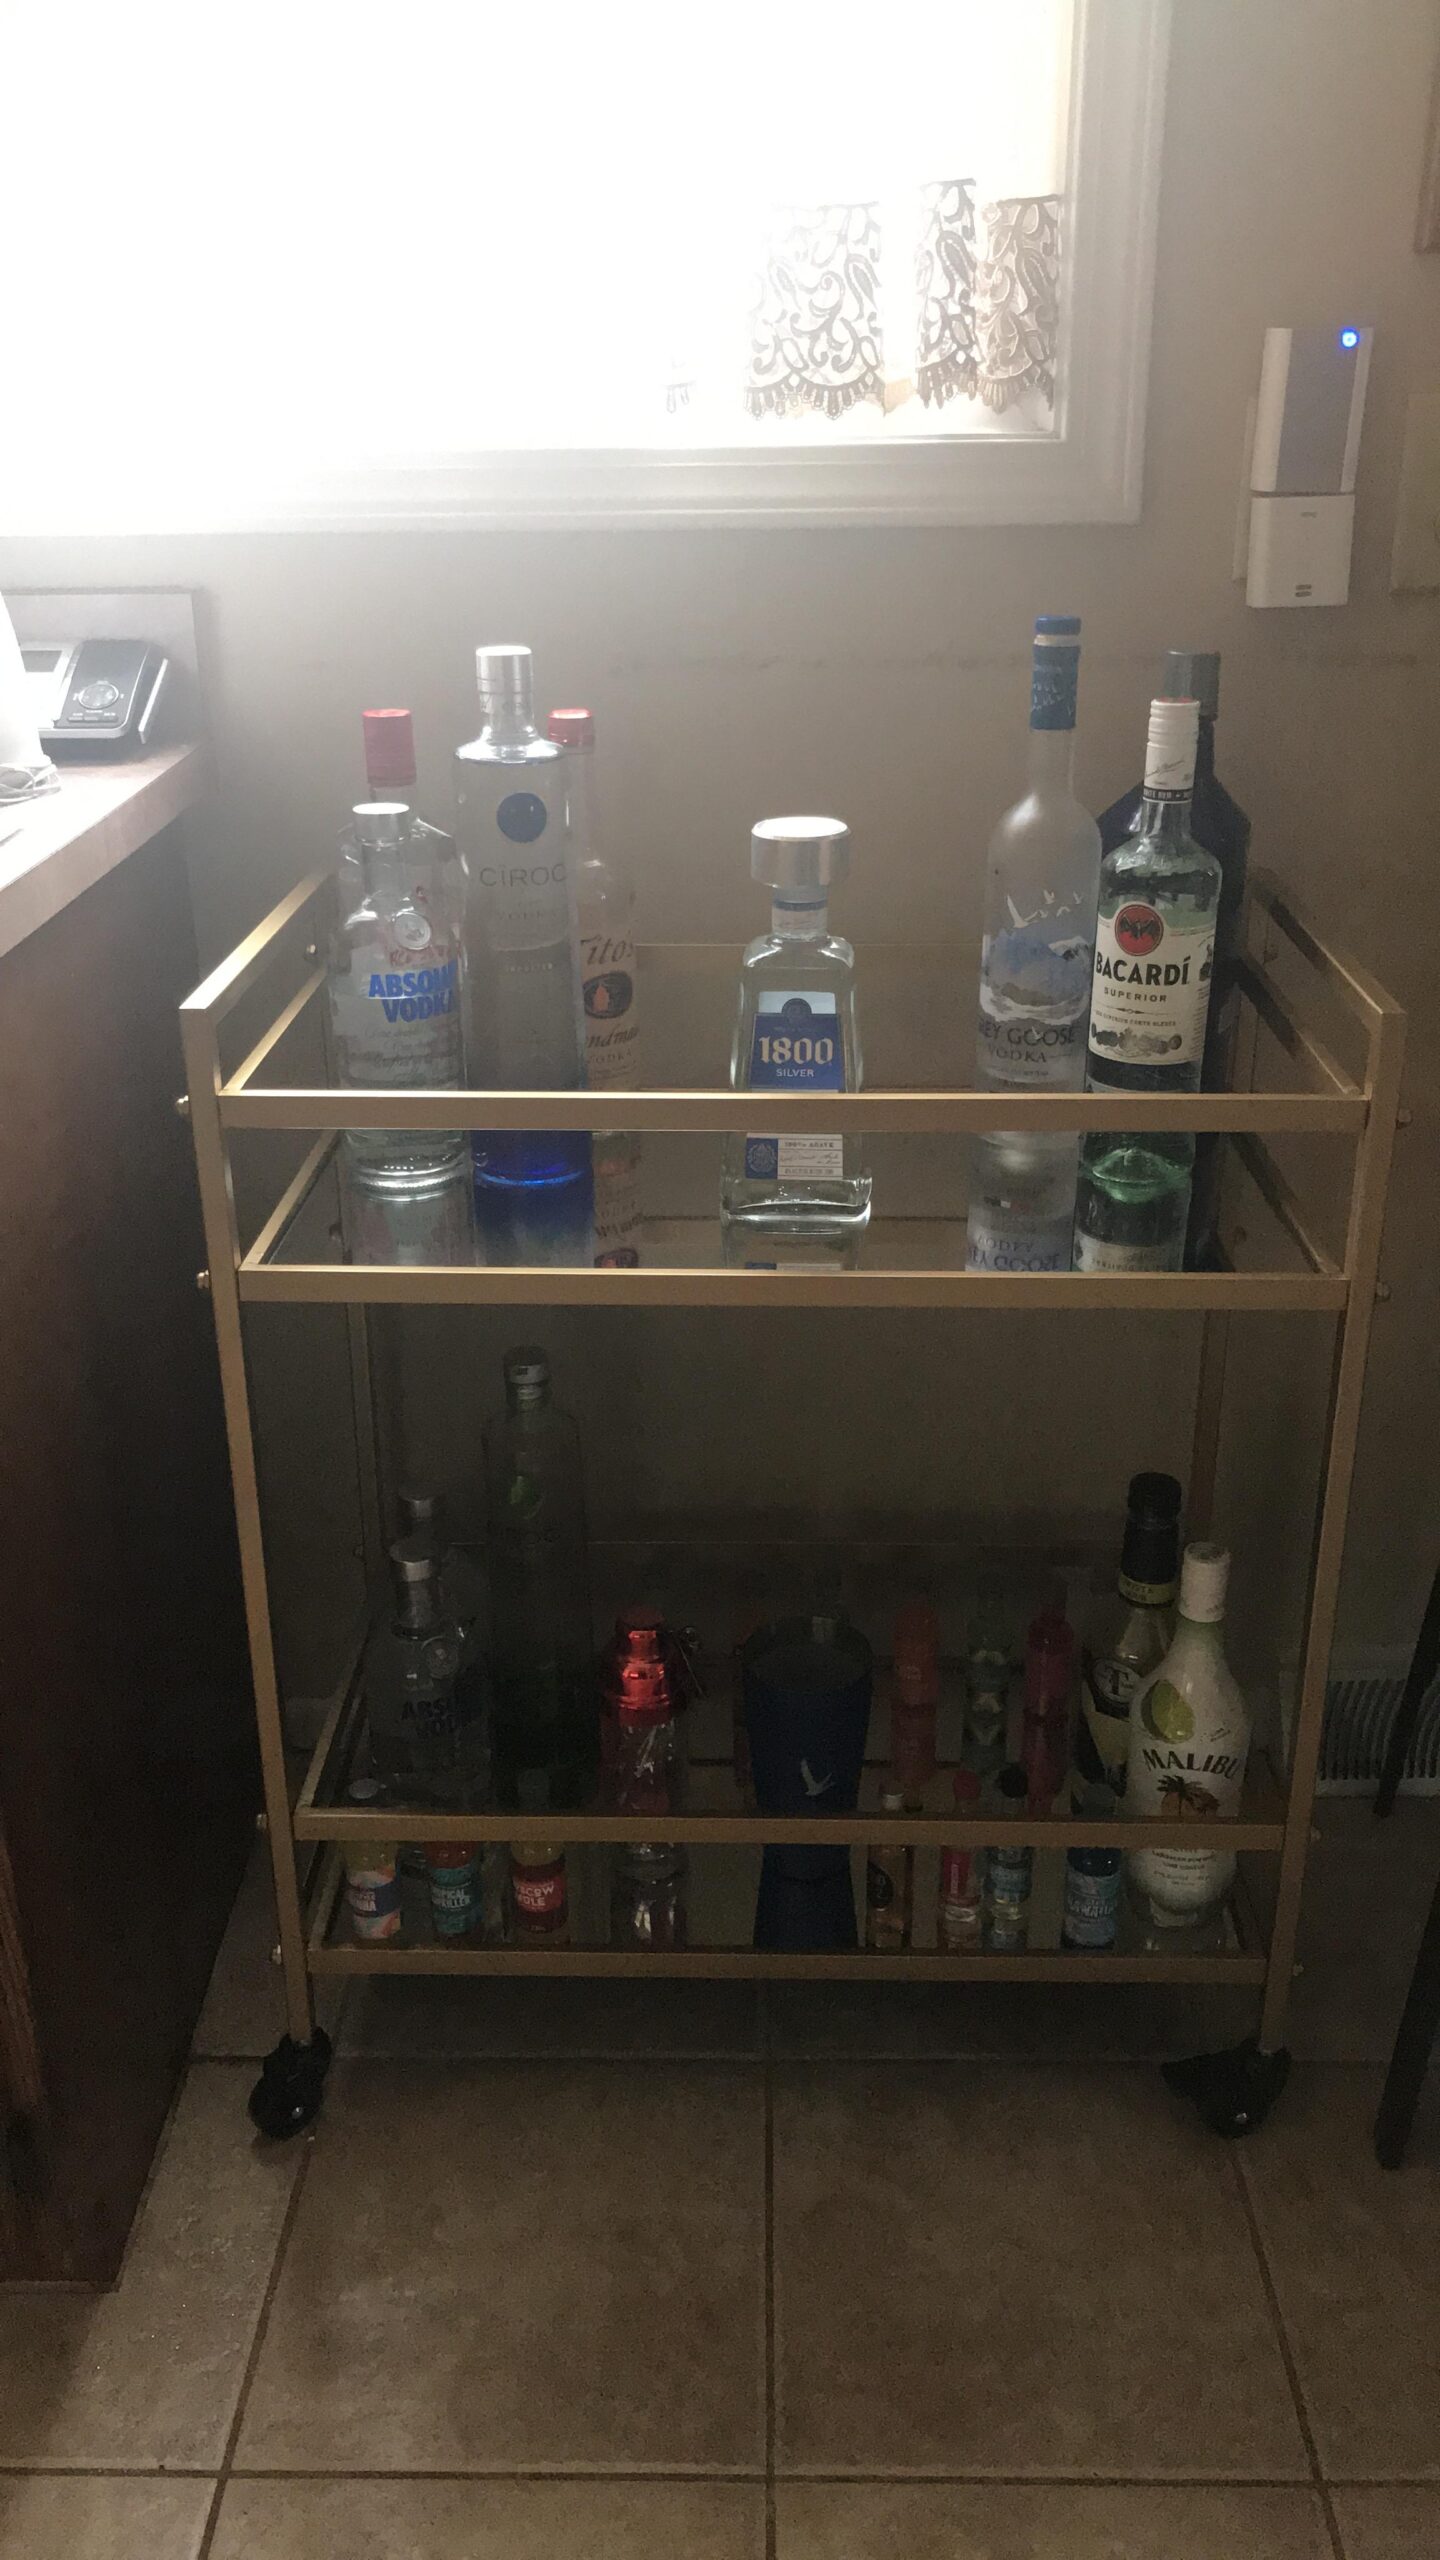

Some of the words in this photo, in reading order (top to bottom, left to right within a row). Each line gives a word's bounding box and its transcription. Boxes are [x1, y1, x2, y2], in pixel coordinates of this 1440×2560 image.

[1095, 951, 1191, 986] BACARDÍ
[1103, 986, 1168, 1003] SUPERIOR
[758, 1036, 834, 1065] 1800
[775, 1068, 815, 1078] SILVER
[1142, 1748, 1239, 1779] MALIBU
